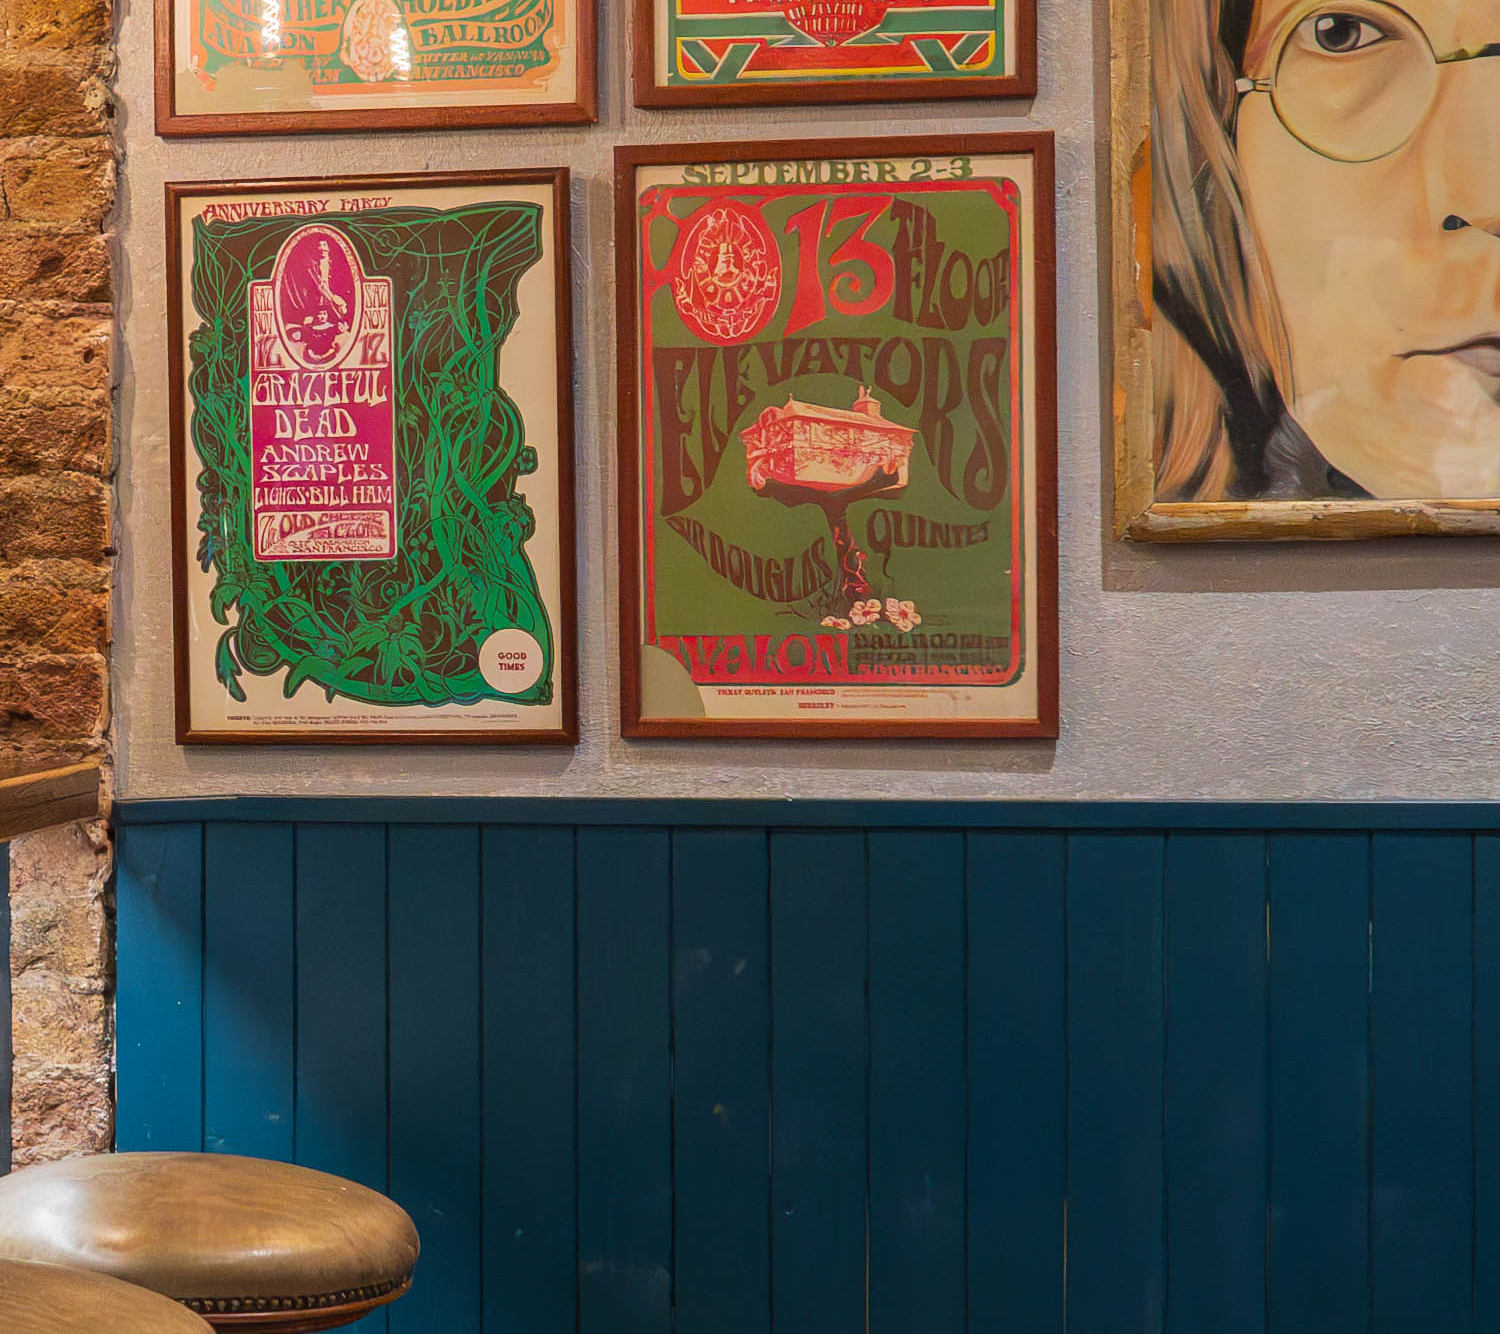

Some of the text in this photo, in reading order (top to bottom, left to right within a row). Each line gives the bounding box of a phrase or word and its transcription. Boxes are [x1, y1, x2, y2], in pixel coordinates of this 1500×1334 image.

[420, 0, 551, 47] BALLROOM
[206, 22, 316, 55] AVAON
[681, 156, 974, 186] SEPTEMBER 2-3
[201, 197, 392, 222] ANNIVERSARY PARTY
[783, 194, 896, 338] 13
[892, 240, 1010, 332] FLOOR
[254, 311, 274, 335] NOV
[364, 309, 388, 330] NOV
[252, 370, 388, 408] GRATEFUL
[274, 407, 358, 442] DEAD
[654, 337, 1009, 518] ELEVATORS
[259, 443, 370, 464] ANDREW
[260, 463, 389, 484] STAPLES
[352, 485, 393, 505] HAM
[279, 513, 317, 540] OLD
[709, 532, 834, 604] DOUGLAS
[866, 508, 991, 579] QUINTET
[497, 651, 528, 661] GOOD
[498, 662, 526, 672] TIMES
